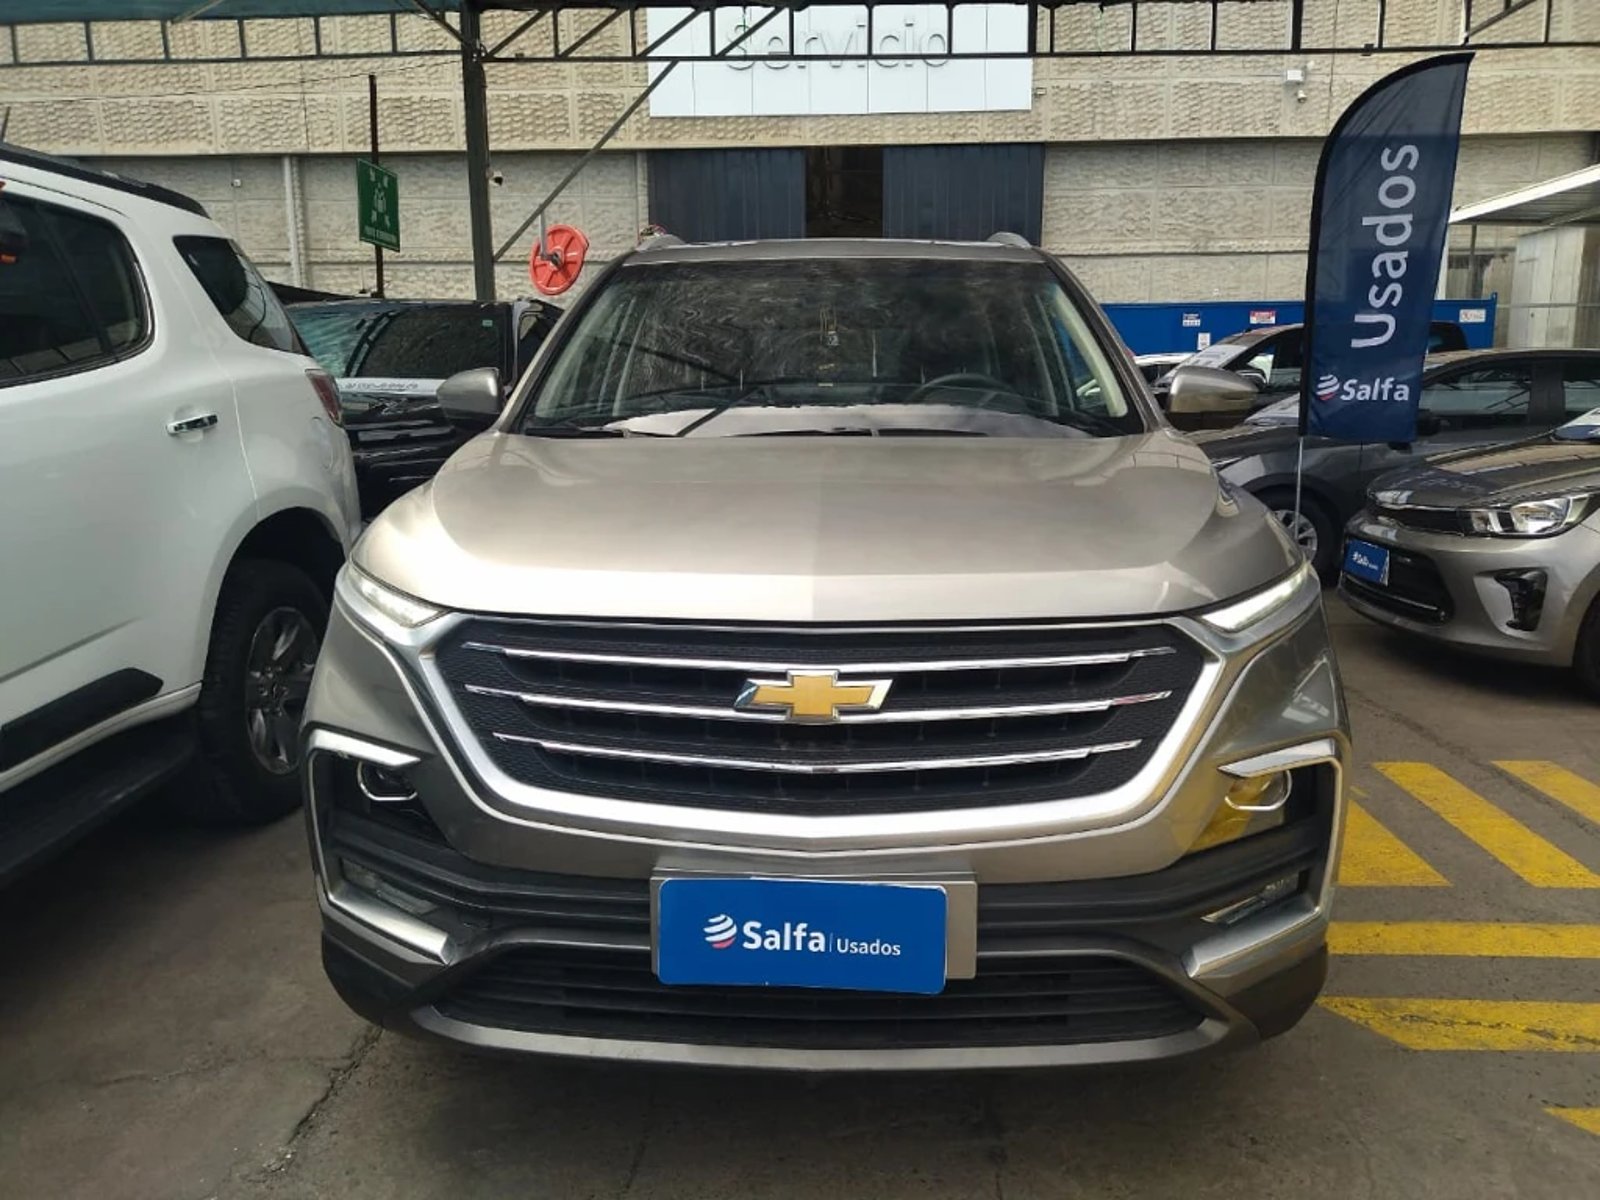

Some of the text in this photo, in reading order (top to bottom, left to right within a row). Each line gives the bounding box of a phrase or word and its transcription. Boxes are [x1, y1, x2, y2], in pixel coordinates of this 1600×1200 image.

[725, 17, 951, 71] Servicio
[1350, 144, 1420, 348] Usados
[1340, 377, 1410, 401] Salfa
[742, 920, 901, 957] Salfa Usados
